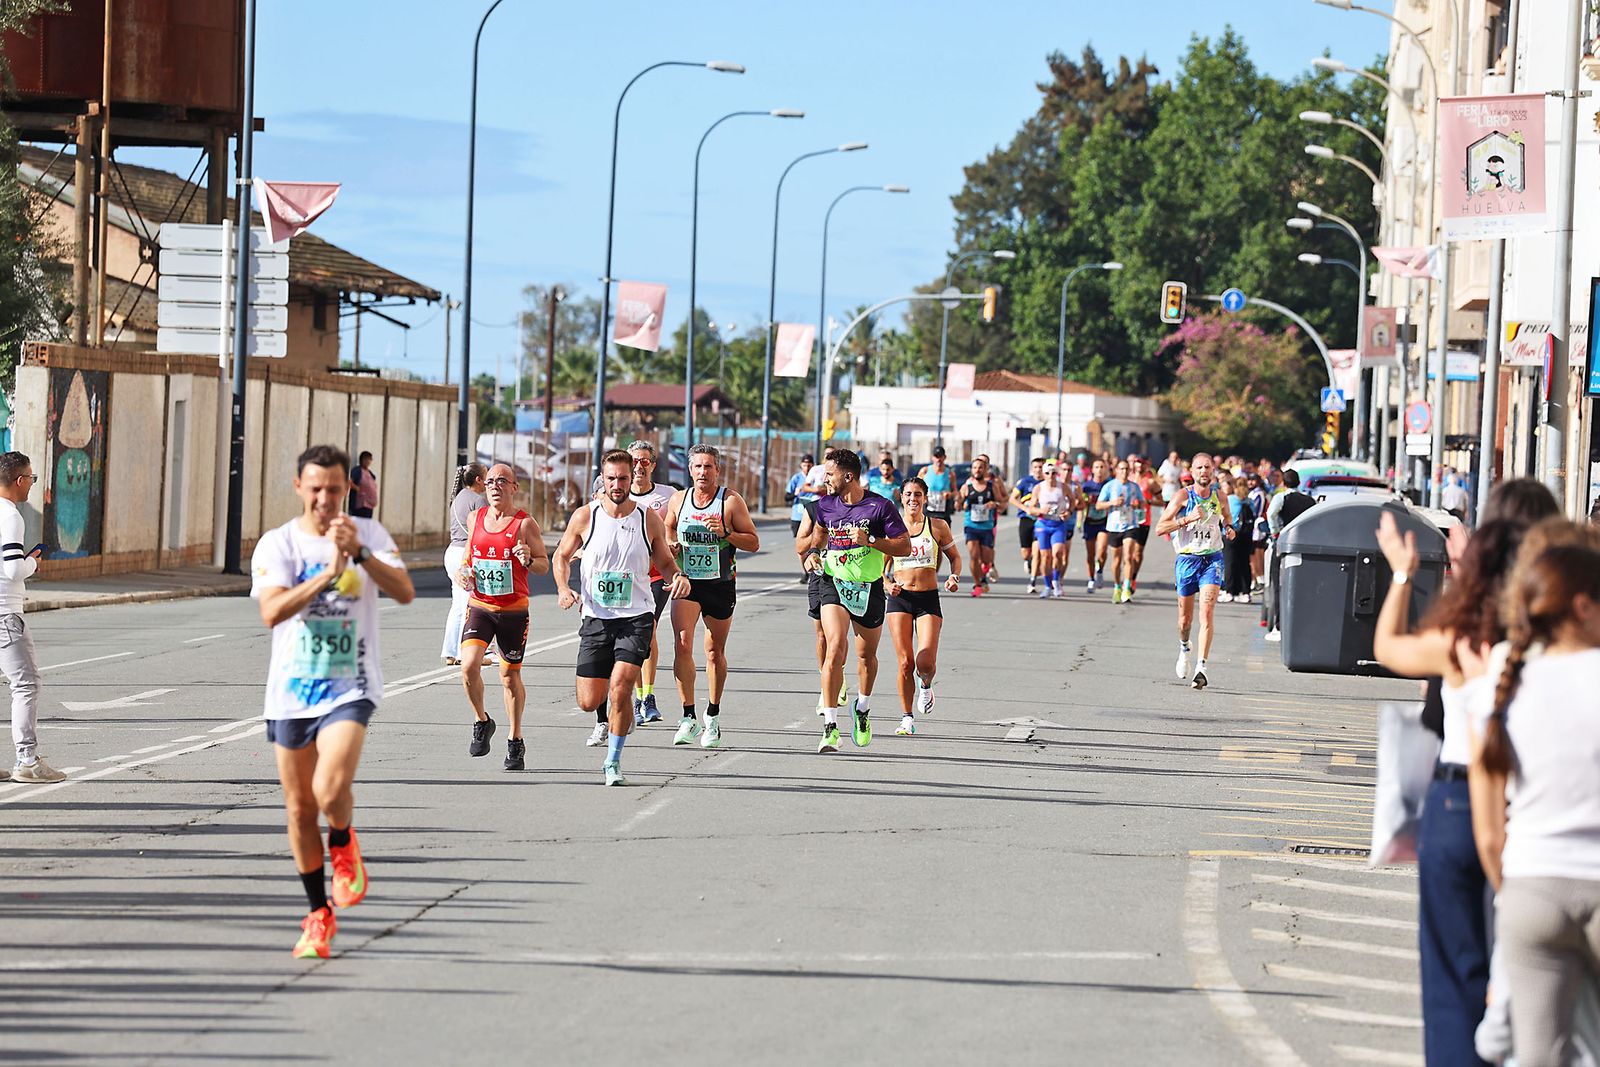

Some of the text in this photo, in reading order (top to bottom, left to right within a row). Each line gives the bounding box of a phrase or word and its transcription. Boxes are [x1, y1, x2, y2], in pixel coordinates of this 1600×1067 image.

[1456, 104, 1489, 117] FERIA
[1477, 114, 1510, 128] LIBRO
[1462, 201, 1526, 214] HUELVA
[1193, 530, 1211, 539] 114
[689, 555, 712, 567] 578
[479, 569, 505, 582] 343
[598, 580, 623, 593] 601
[301, 634, 352, 655] 1350
